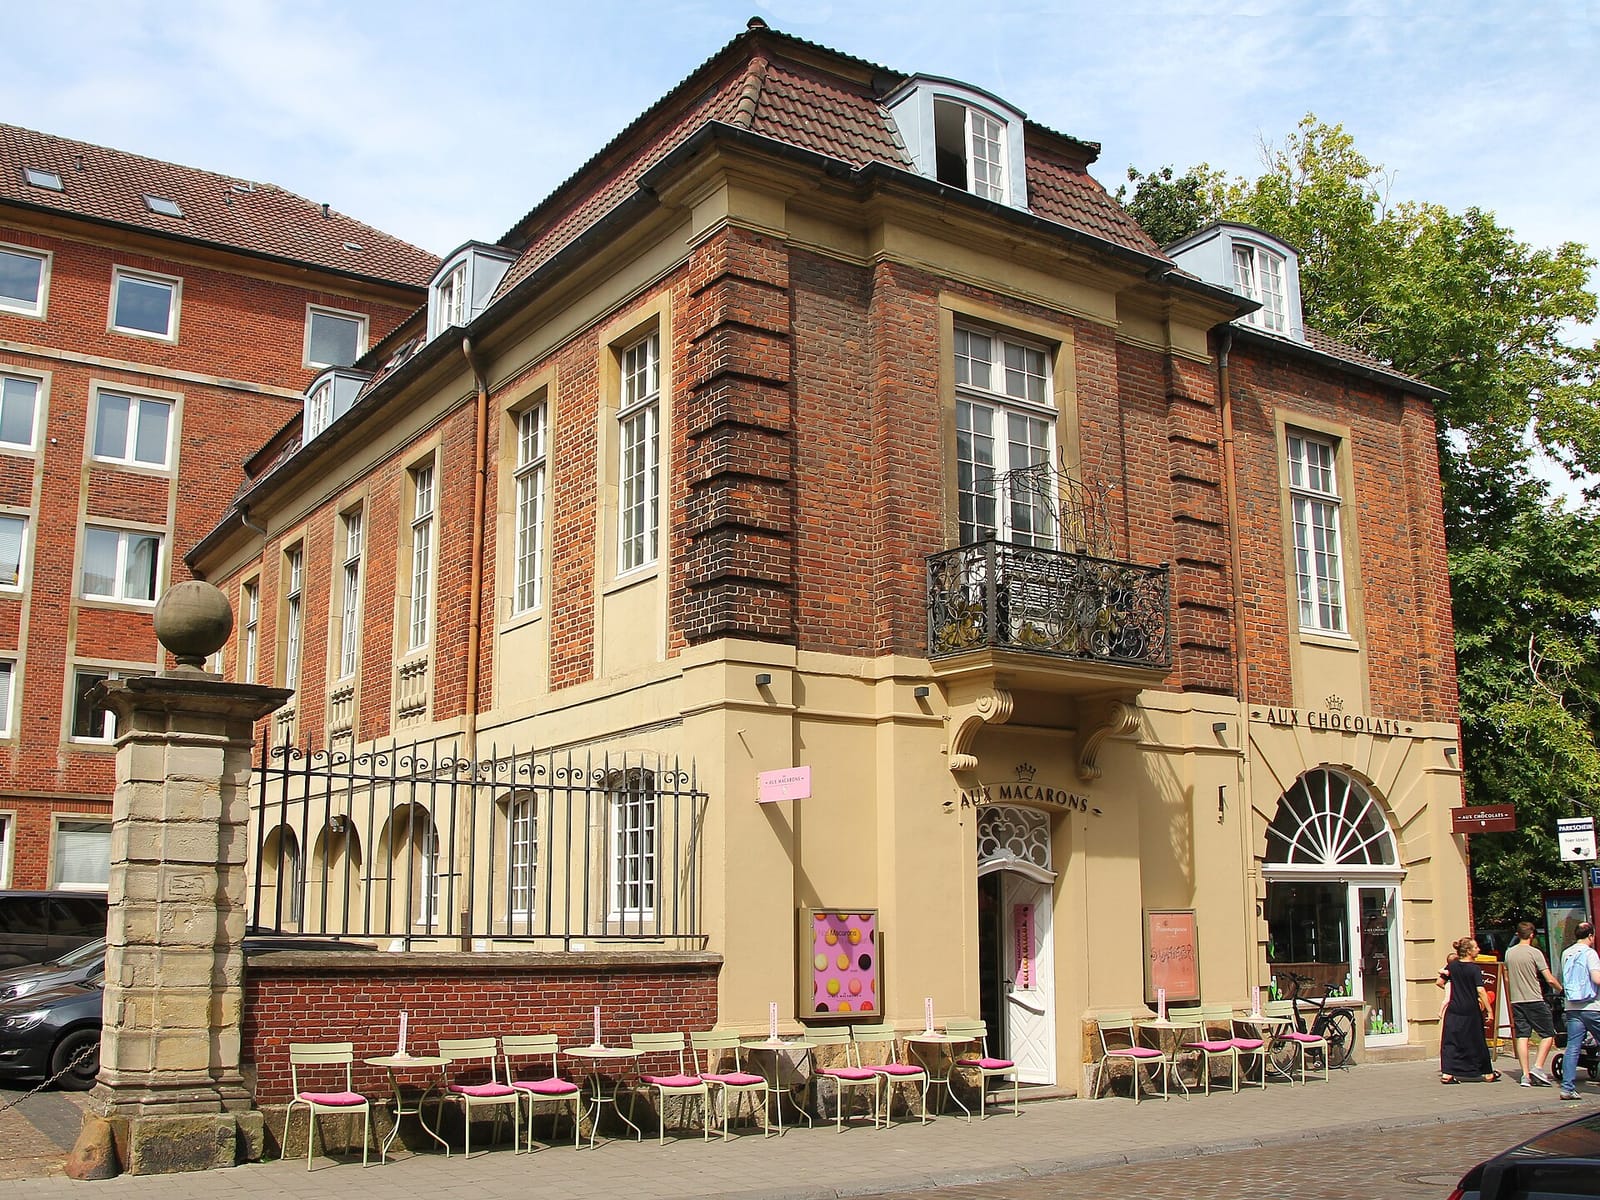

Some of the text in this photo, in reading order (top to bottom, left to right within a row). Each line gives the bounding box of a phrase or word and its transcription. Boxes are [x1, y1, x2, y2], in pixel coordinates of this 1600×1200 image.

[1267, 708, 1400, 735] AUX CHOCOLATS
[960, 785, 1088, 812] AUX MACARONS
